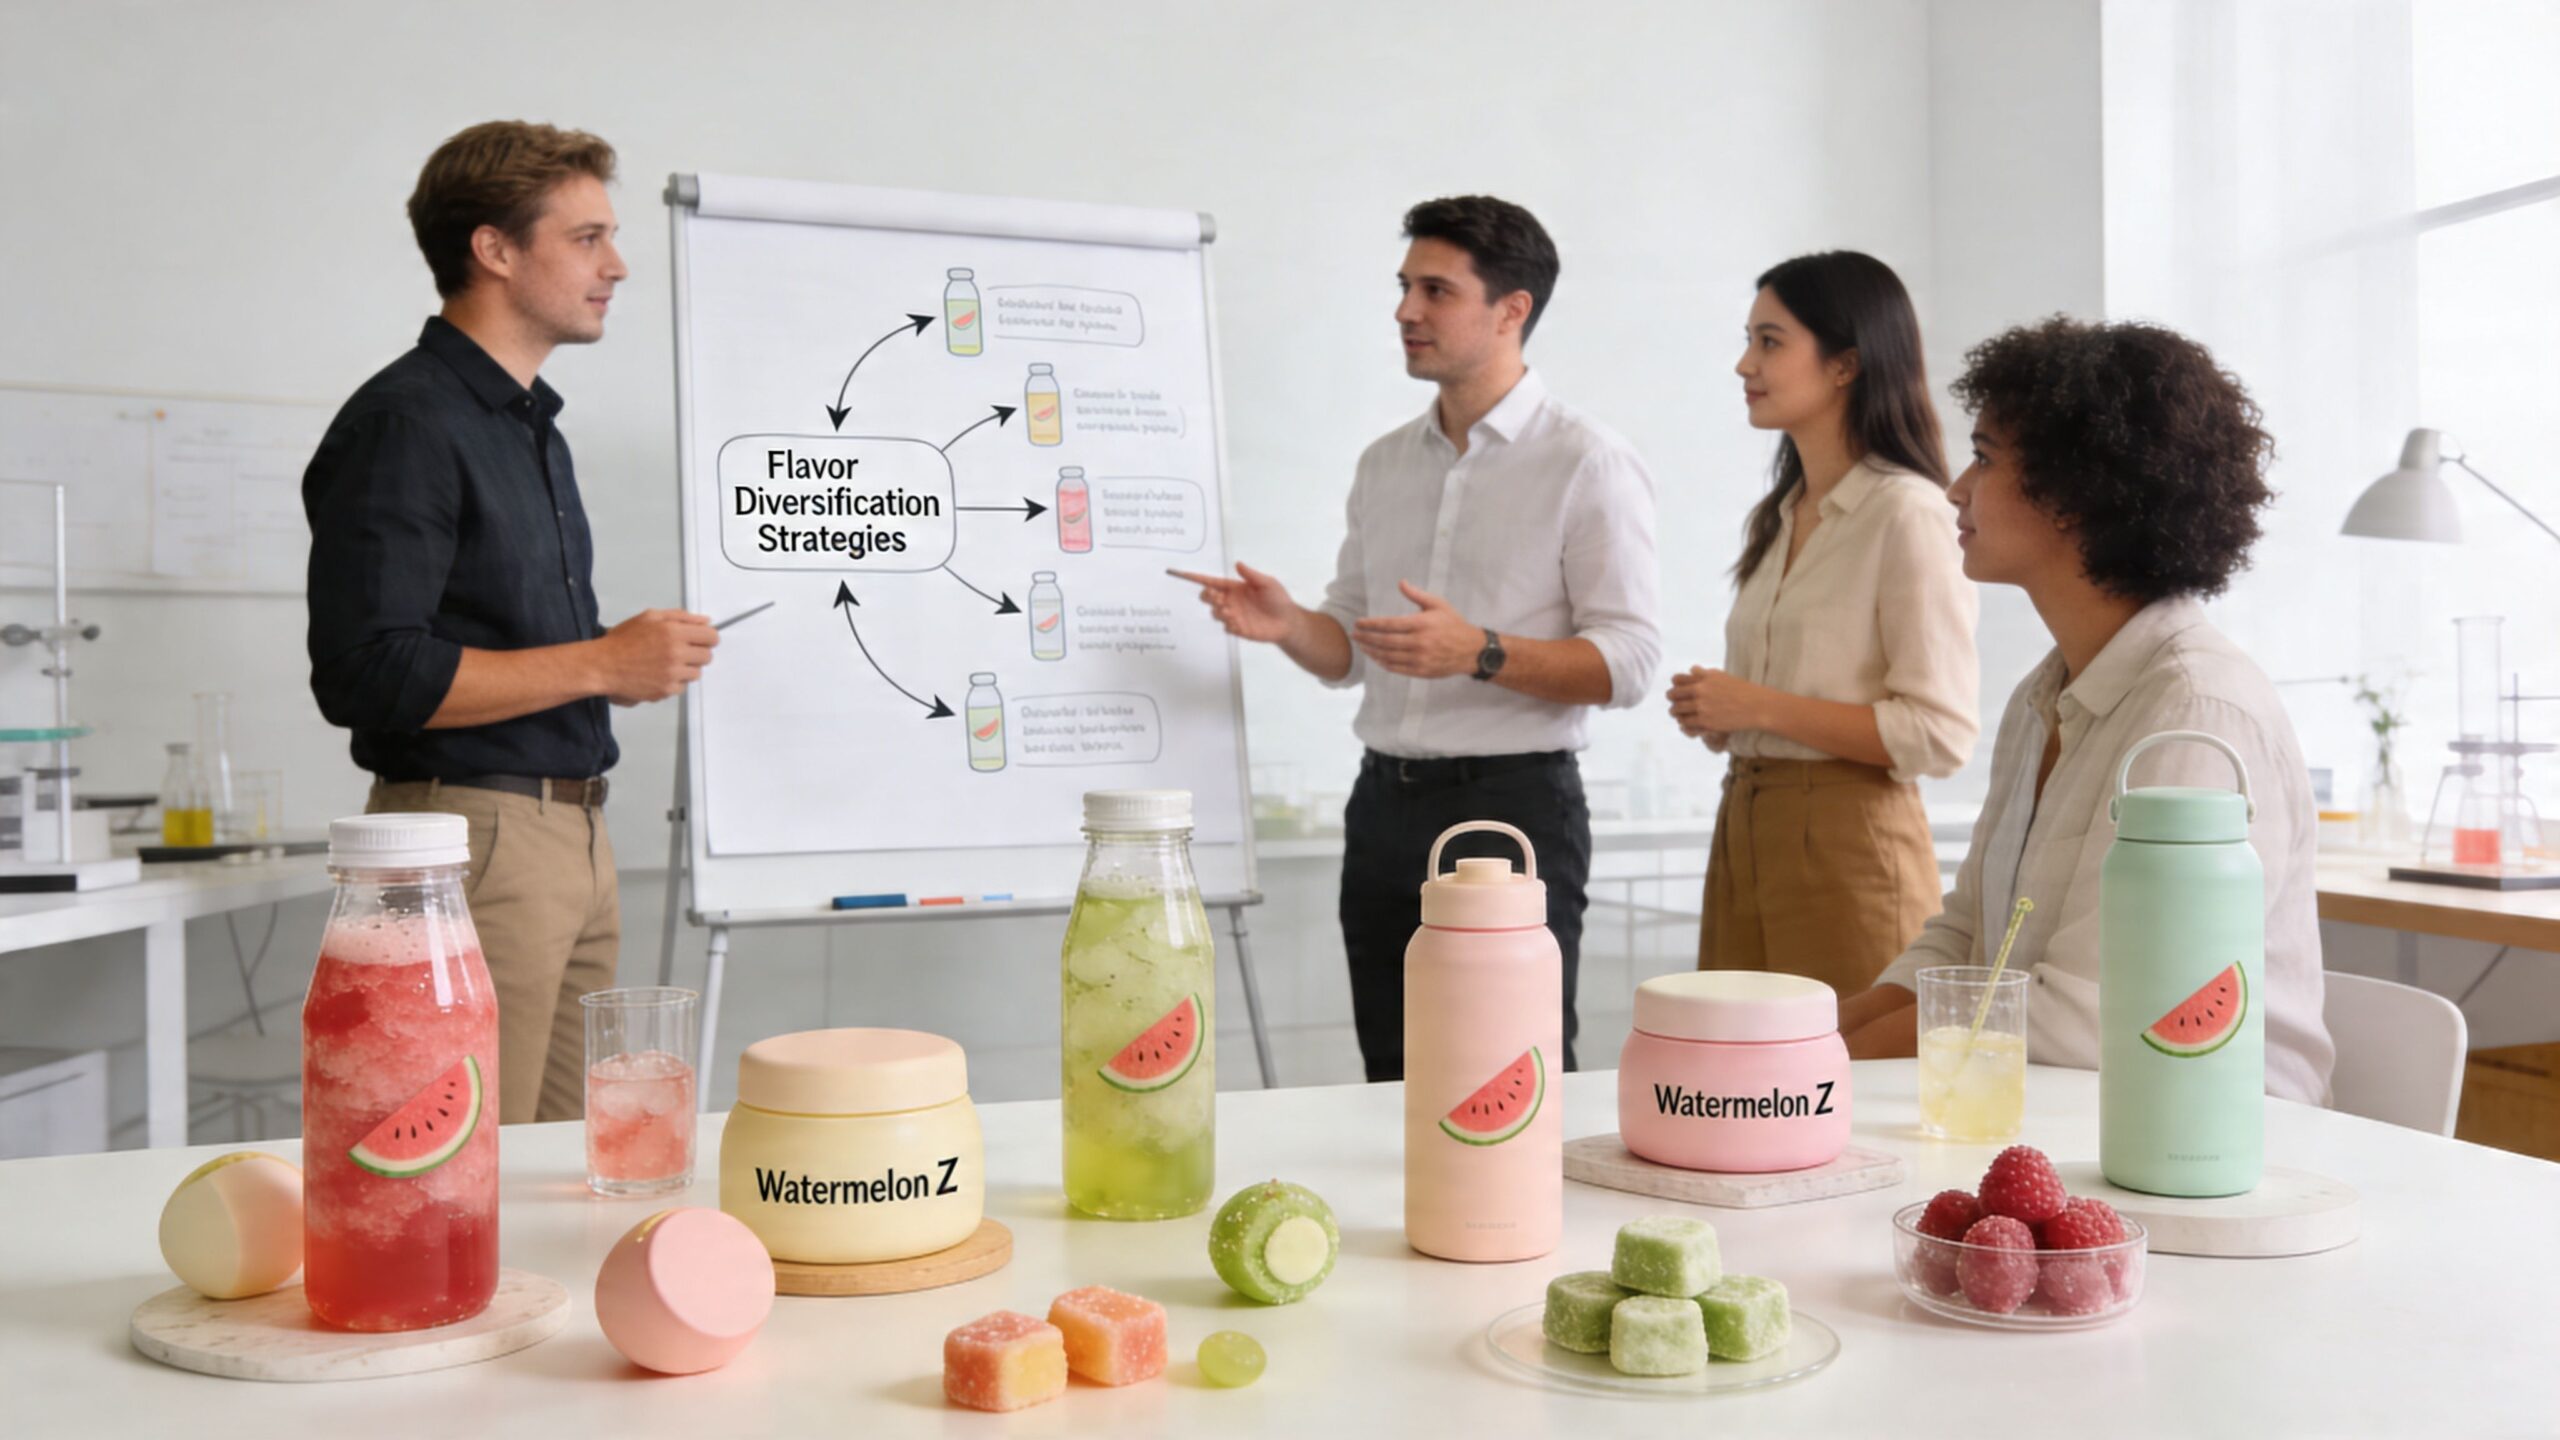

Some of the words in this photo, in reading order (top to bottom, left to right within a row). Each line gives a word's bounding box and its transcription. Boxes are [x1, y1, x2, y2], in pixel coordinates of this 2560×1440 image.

[767, 449, 859, 480] Flavor
[734, 485, 940, 517] Diversification
[757, 523, 907, 561] Strategies
[1653, 1083, 1809, 1119] Watermelon
[1814, 1081, 1835, 1117] Z
[755, 1167, 930, 1205] Watermelon
[935, 1156, 959, 1197] Z
